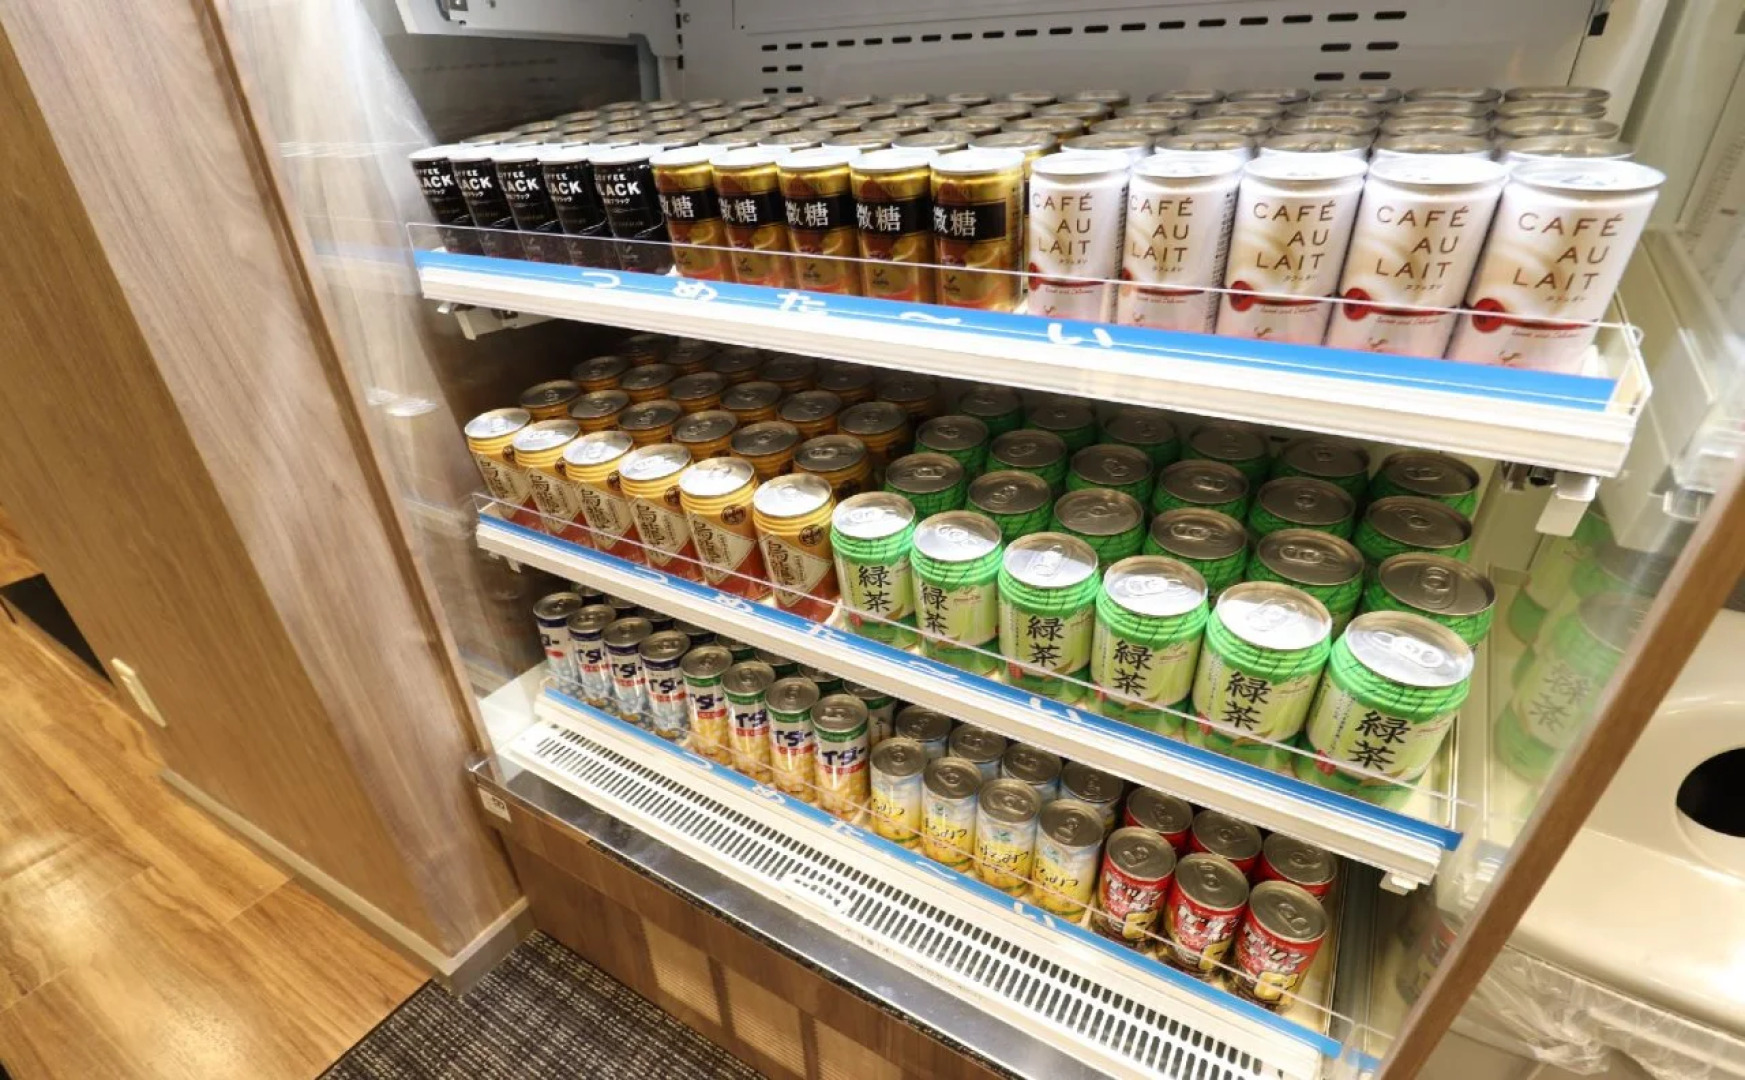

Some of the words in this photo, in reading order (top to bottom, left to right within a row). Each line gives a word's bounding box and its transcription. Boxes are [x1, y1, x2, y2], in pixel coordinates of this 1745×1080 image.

[423, 174, 454, 189] ACK
[461, 176, 493, 190] ACK
[506, 178, 540, 193] ACK
[550, 180, 583, 196] ACK
[1032, 192, 1093, 212] CAFÉ
[1130, 196, 1194, 217] CAFÉ
[1253, 200, 1337, 223] CAFÉ
[785, 199, 829, 227] 微糖
[856, 202, 902, 233] 微糖
[933, 204, 978, 237] 微糖
[1376, 205, 1470, 228] CAFÉ
[1056, 218, 1091, 234] AU
[1152, 224, 1190, 241] AU
[1518, 212, 1624, 237] CAFÉ
[1038, 238, 1091, 256] LAIT
[1287, 229, 1330, 248] AU
[1411, 236, 1459, 255] AU
[1131, 242, 1189, 263] LAIT
[1256, 251, 1326, 271] LAIT
[1555, 245, 1611, 264] AU
[1375, 258, 1453, 280] LAIT
[1512, 267, 1600, 291] LAIT
[858, 565, 893, 614] 緑茶
[922, 585, 949, 636] 緑茶
[1027, 616, 1065, 668] 緑茶
[1112, 638, 1153, 697] 緑茶
[1221, 670, 1272, 732] 緑茶
[1346, 709, 1412, 771] 緑茶
